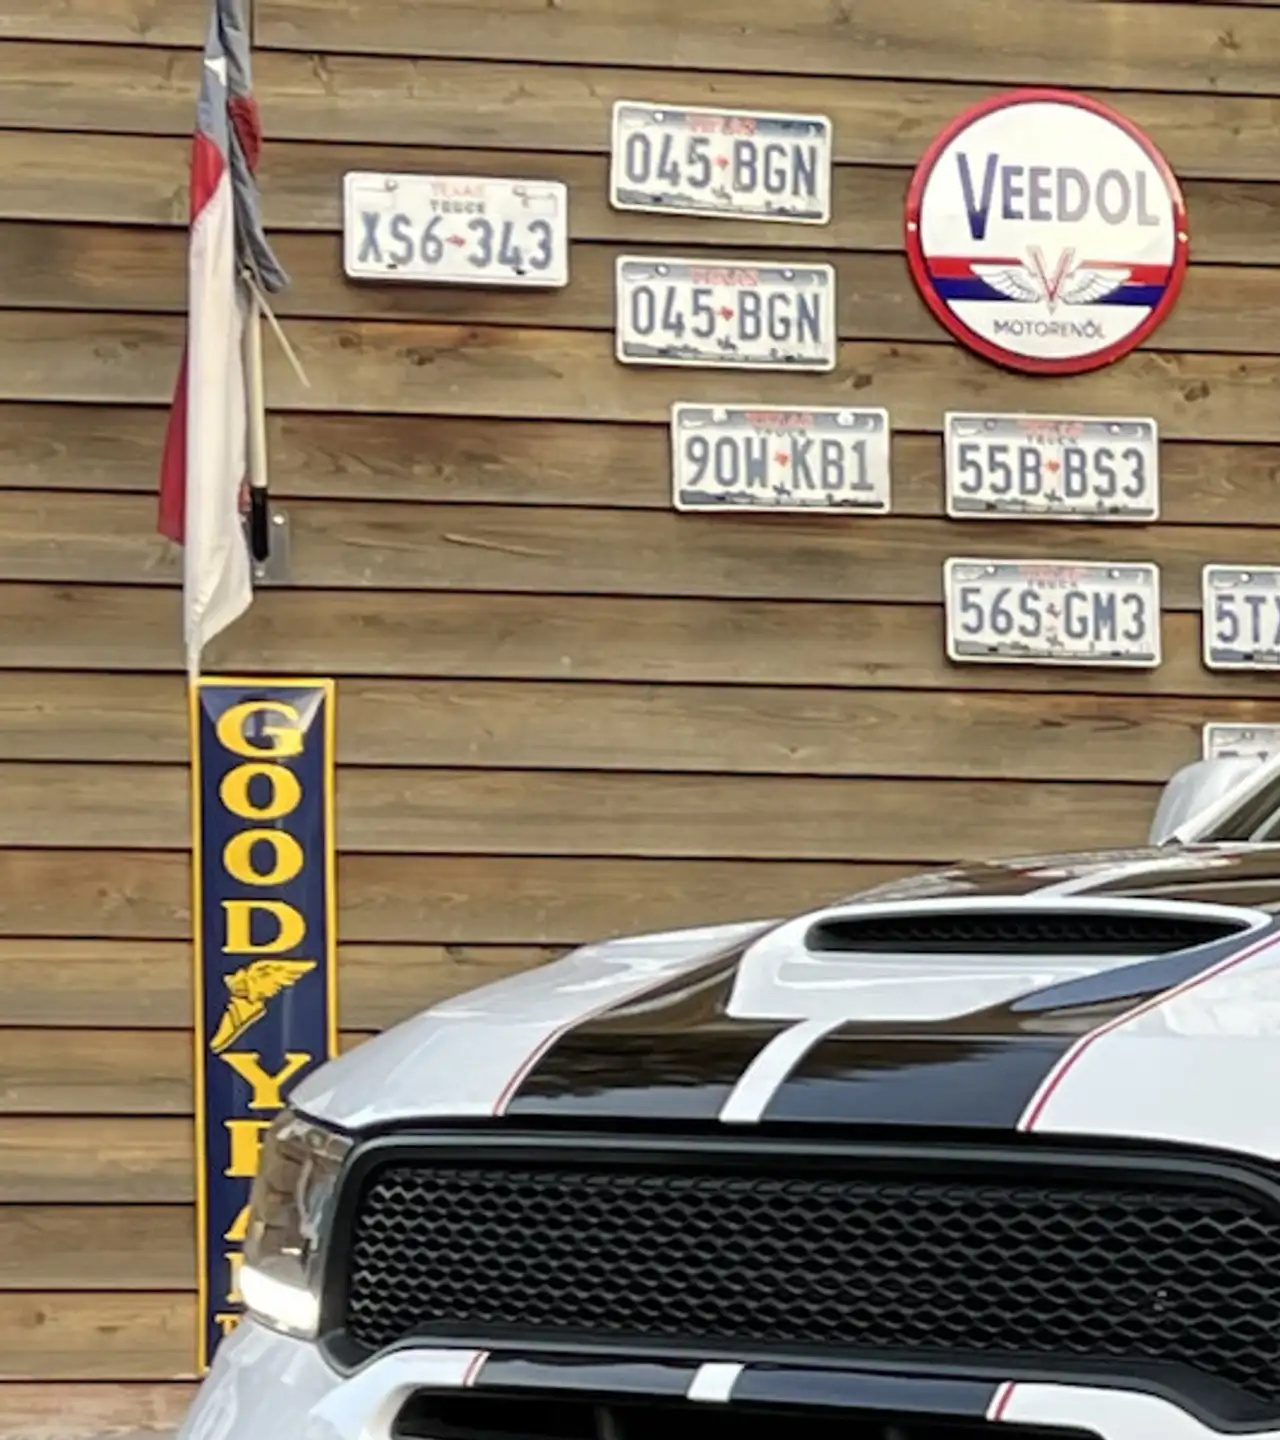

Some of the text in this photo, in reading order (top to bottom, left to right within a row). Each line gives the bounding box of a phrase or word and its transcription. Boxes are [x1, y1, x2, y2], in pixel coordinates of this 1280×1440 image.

[625, 132, 817, 196] 045 BGN
[956, 152, 1160, 240] VEEDOL
[357, 211, 553, 270] XS6 343
[631, 285, 820, 344] 045 BGN
[791, 437, 874, 491] KB1
[958, 444, 1146, 498] 55B BS3
[960, 587, 1146, 642] 56S GM3
[216, 699, 306, 955] GOOD
